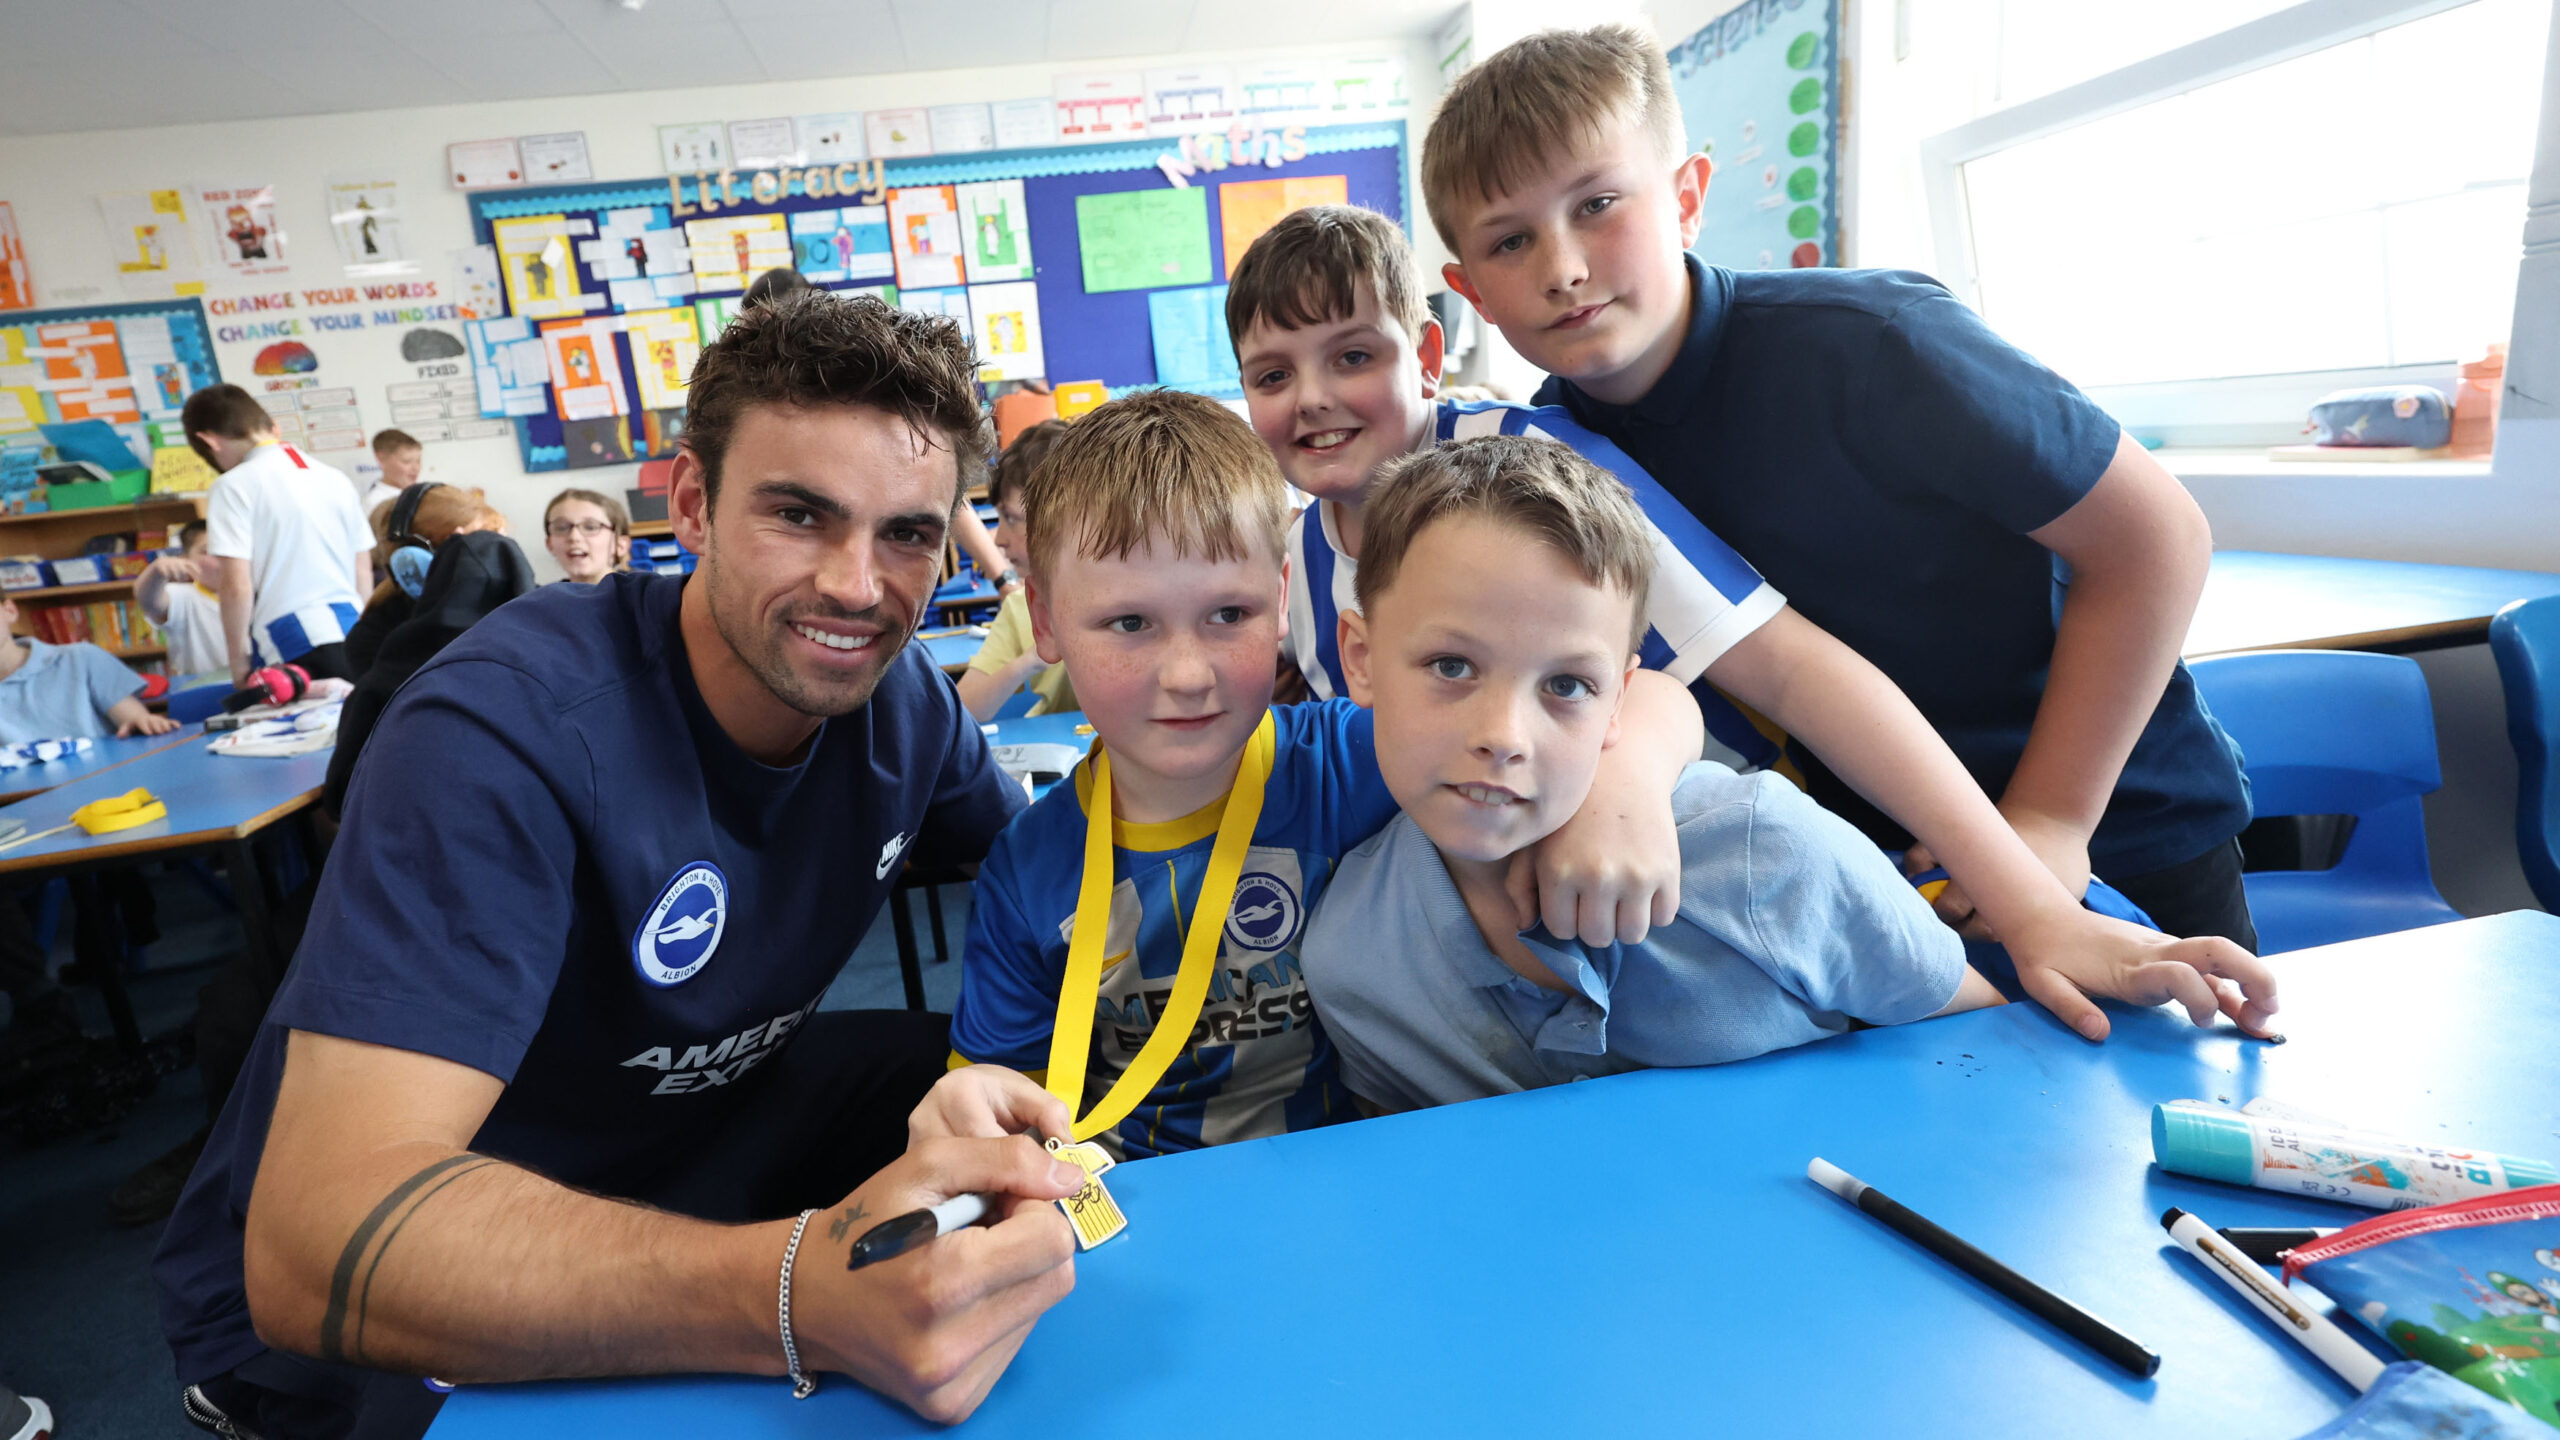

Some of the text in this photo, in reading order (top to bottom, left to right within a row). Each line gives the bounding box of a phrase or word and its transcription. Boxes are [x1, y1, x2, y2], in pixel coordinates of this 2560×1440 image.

[1157, 116, 1307, 189] Maths
[669, 158, 886, 218] Literacy
[210, 281, 438, 316] CHANGE YOUR WORDS
[217, 303, 459, 343] CHANGE YOUR MINDSET
[265, 377, 320, 392] GROWTH
[417, 364, 460, 379] FIXED
[881, 831, 905, 865] NIKE
[660, 872, 722, 912] BRIGHTON & HOVE
[1265, 880, 1283, 894] HOVE
[1253, 934, 1279, 946] ALBION
[661, 964, 697, 981] ALBION
